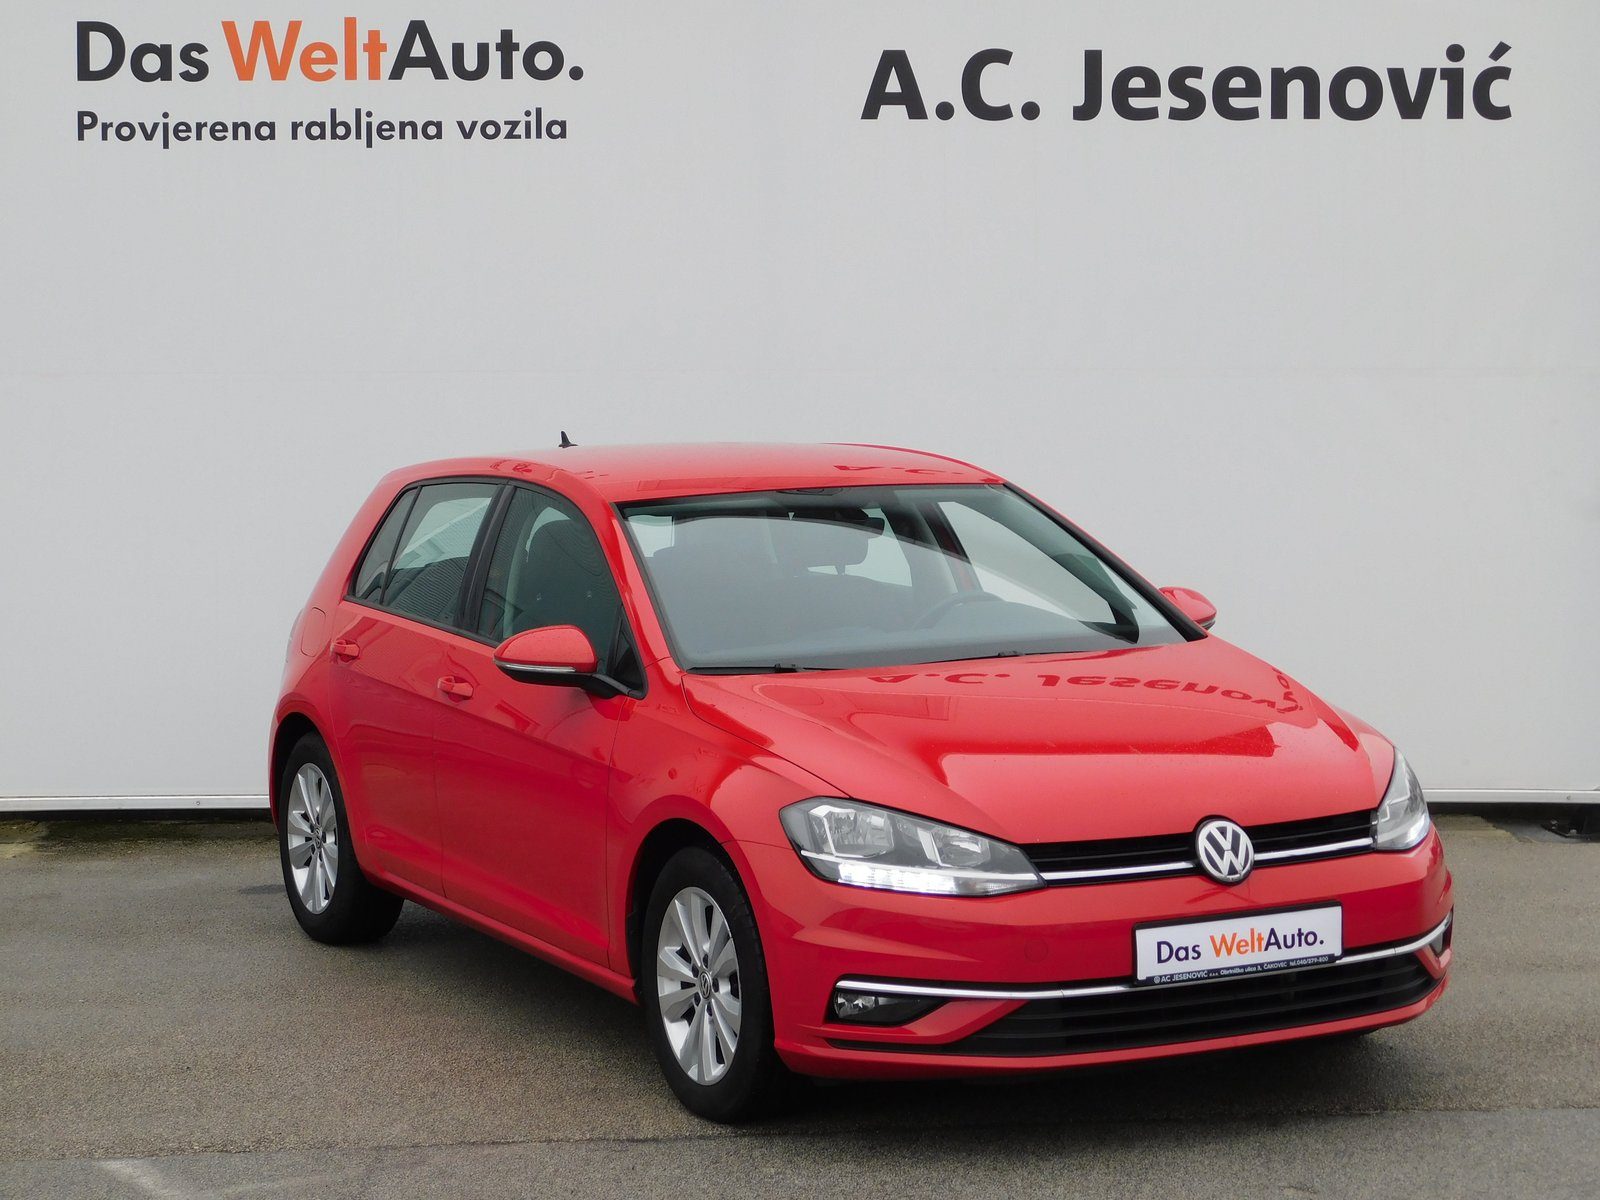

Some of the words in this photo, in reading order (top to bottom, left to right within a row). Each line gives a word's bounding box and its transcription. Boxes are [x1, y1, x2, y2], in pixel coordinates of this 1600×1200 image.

[77, 21, 209, 82] Das
[222, 17, 584, 82] WeltAuto.
[861, 48, 1041, 121] A.C.
[1073, 42, 1512, 121] Jesenović
[77, 111, 276, 149] Provjerena
[292, 107, 443, 149] rabljena
[456, 107, 567, 141] vozila
[1156, 940, 1202, 964] Das
[1209, 927, 1325, 958] WeltAuto.
